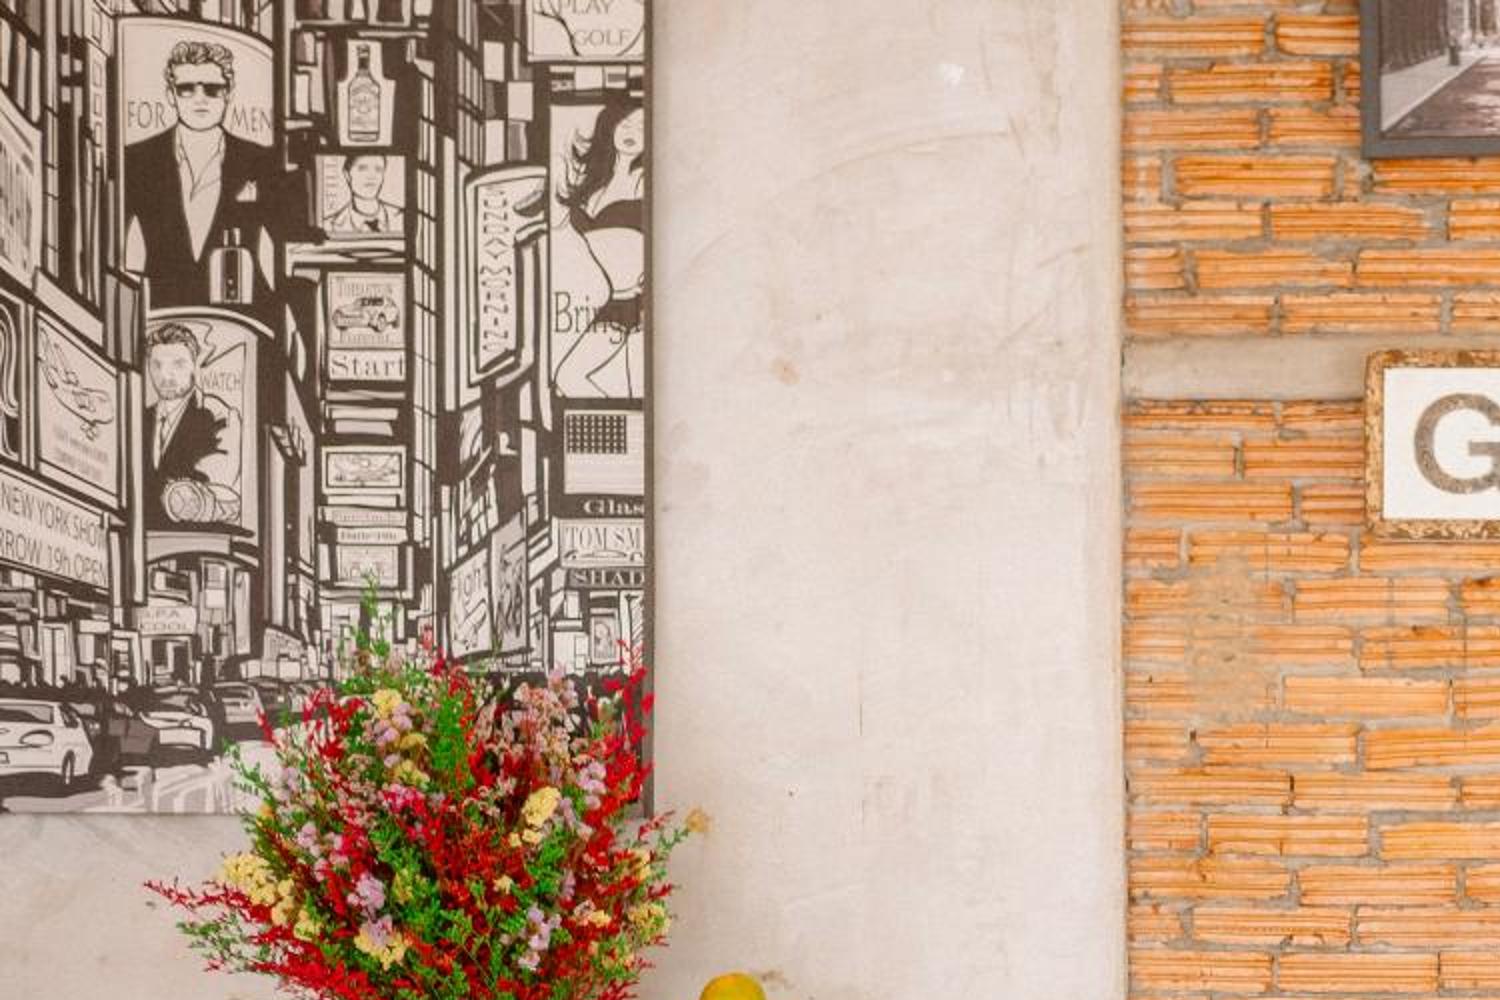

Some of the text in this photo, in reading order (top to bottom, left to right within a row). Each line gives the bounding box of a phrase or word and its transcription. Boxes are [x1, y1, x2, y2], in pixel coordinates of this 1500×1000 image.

[574, 28, 632, 46] GOLF
[127, 101, 272, 132] FOR MEN
[330, 354, 405, 377] Start
[200, 369, 242, 393] WATCH
[1, 480, 35, 522] NEW
[36, 496, 71, 538] YORK
[74, 552, 108, 587] OPEN
